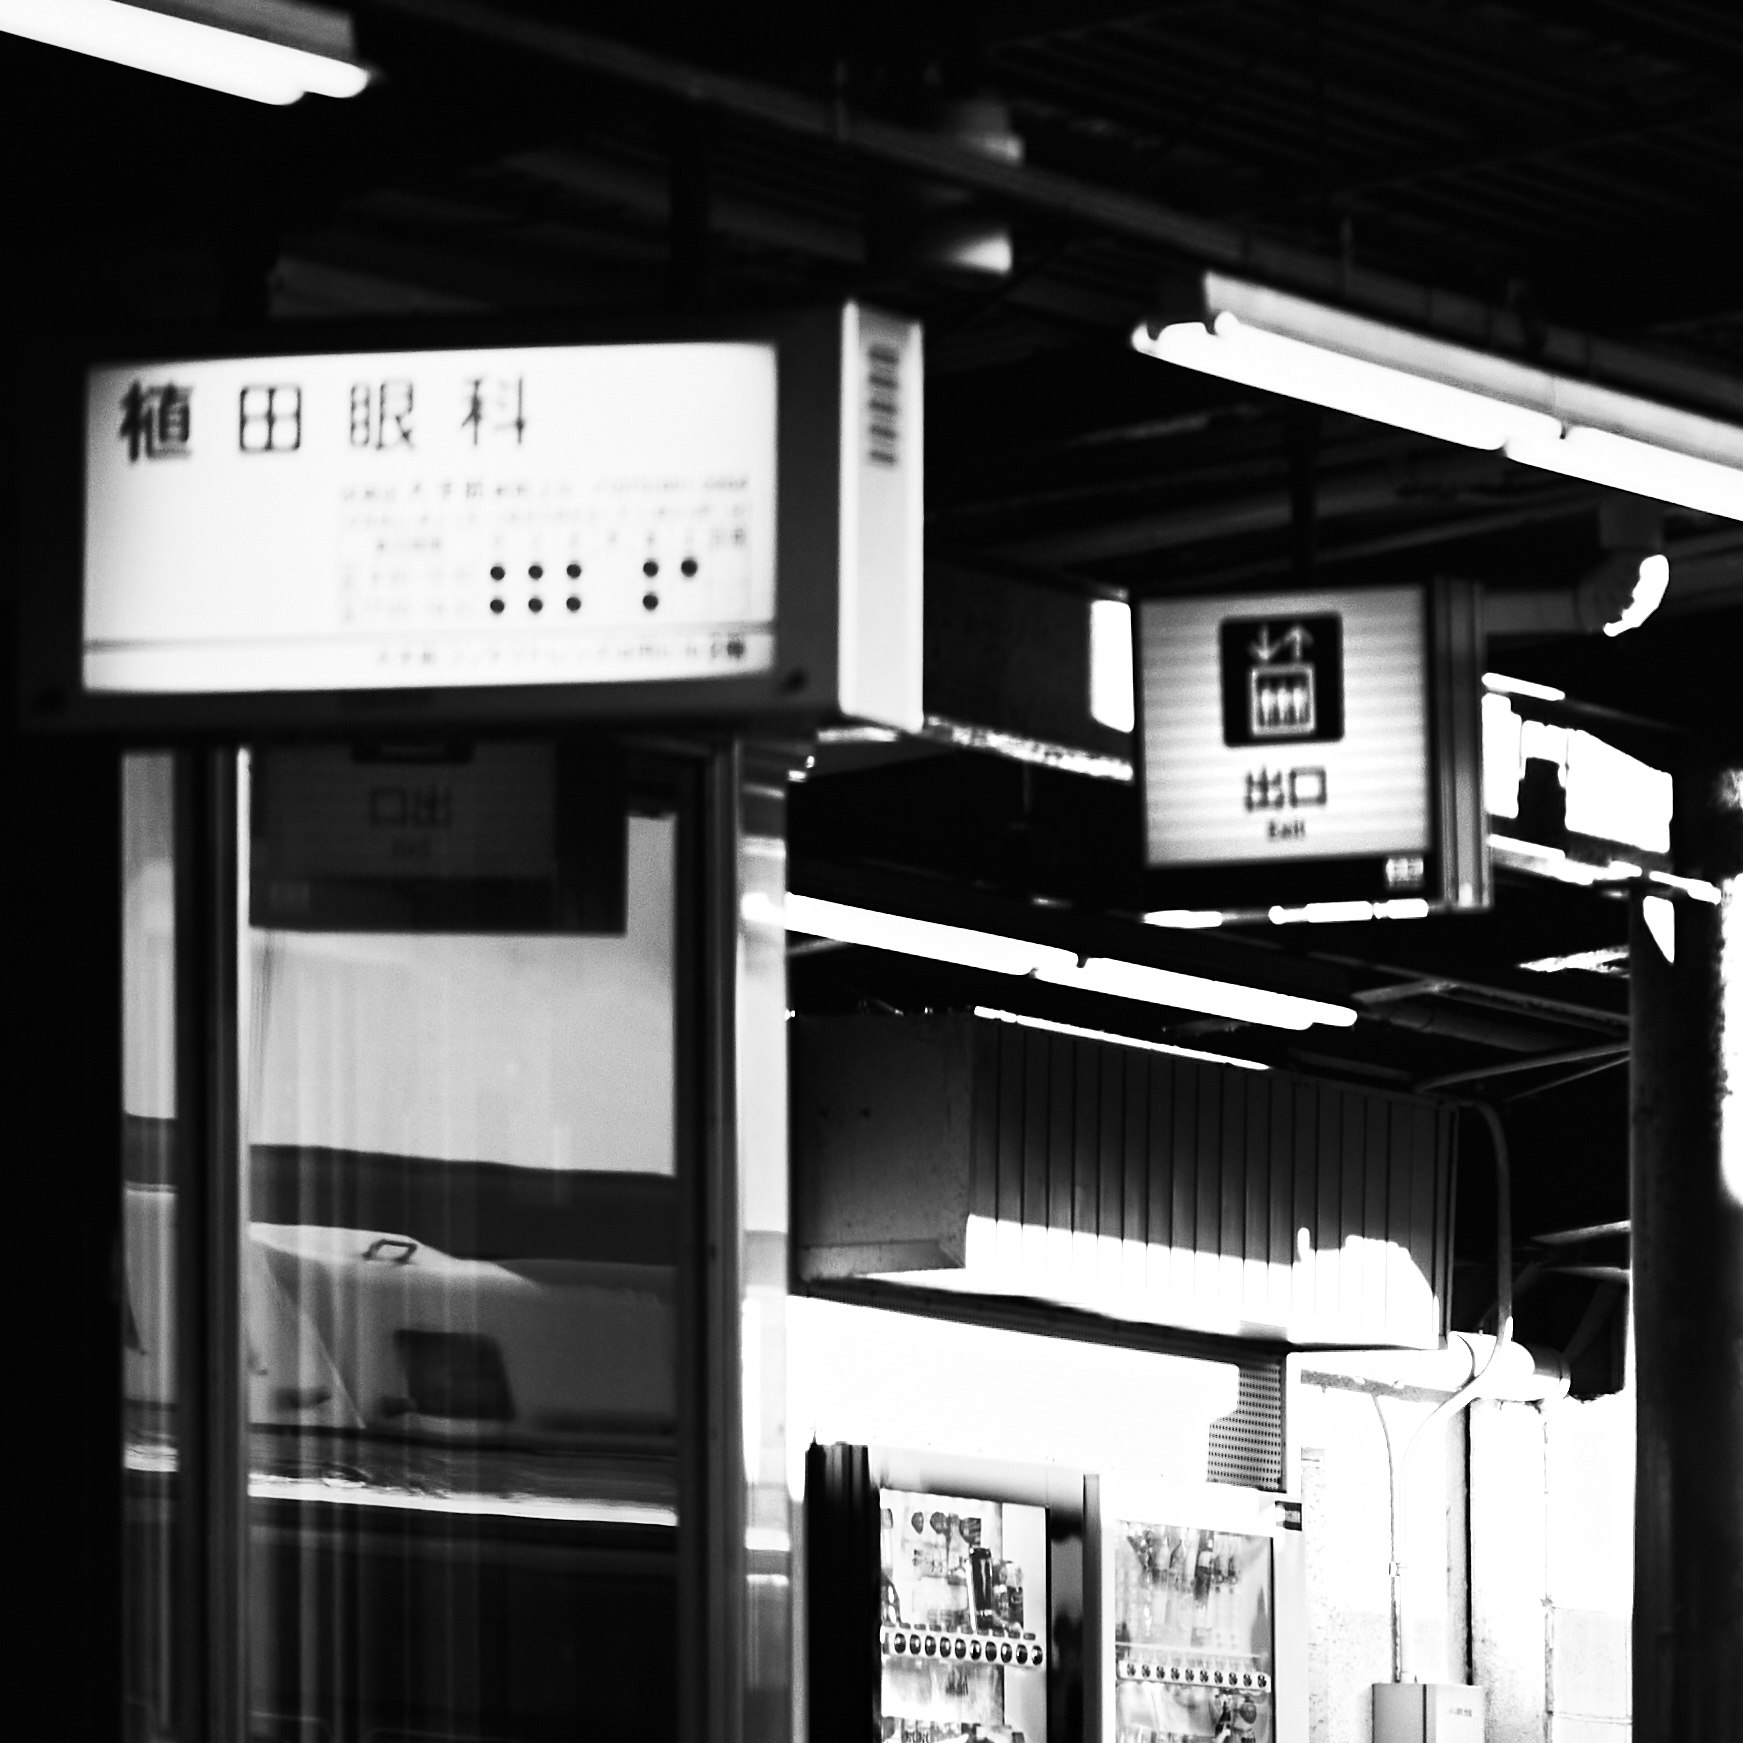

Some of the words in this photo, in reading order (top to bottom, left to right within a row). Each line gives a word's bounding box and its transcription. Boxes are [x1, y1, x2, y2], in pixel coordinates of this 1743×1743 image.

[120, 376, 528, 463] 植田眼科
[1244, 764, 1328, 813] 出口
